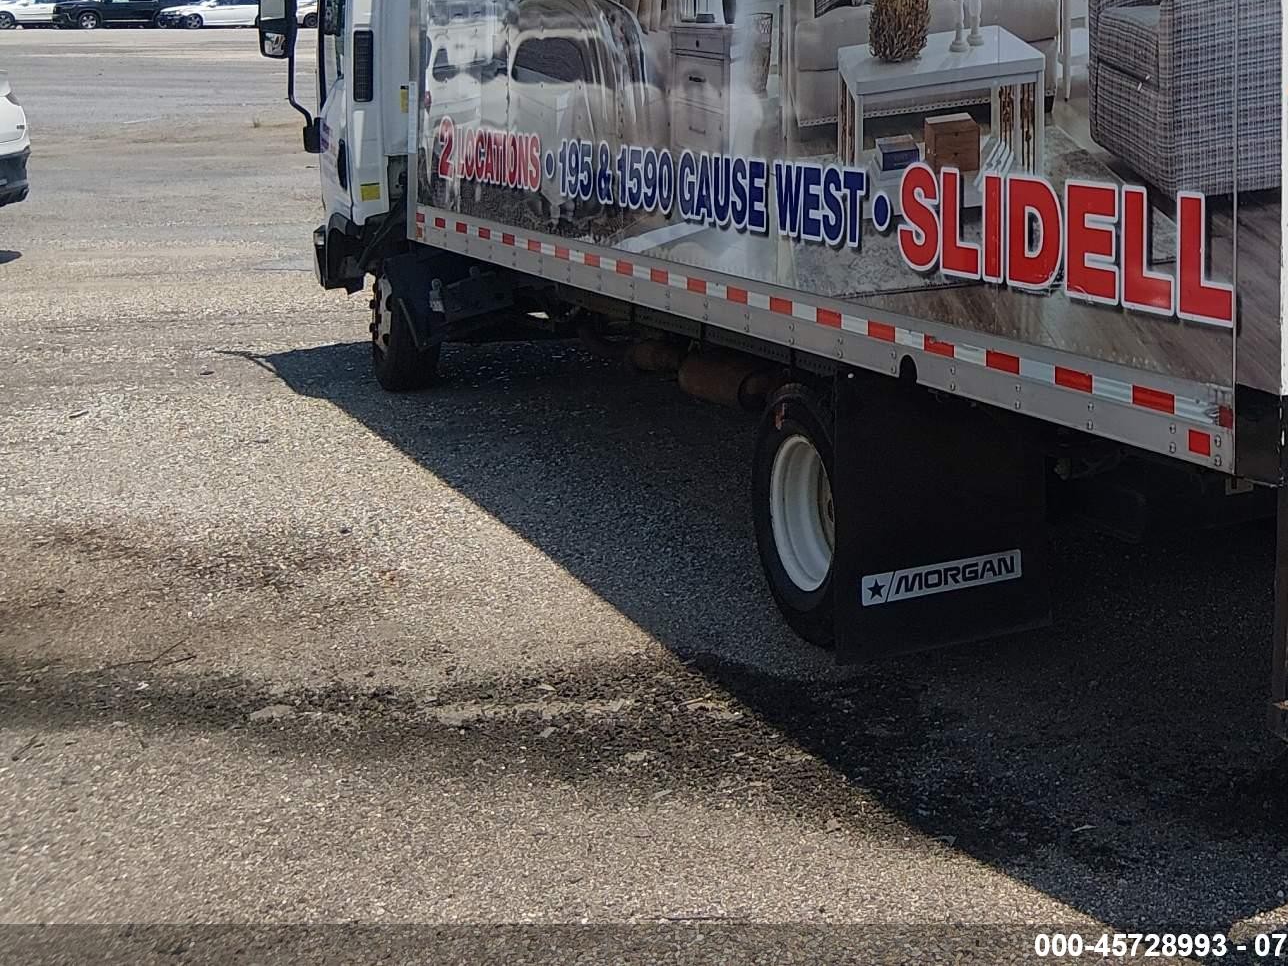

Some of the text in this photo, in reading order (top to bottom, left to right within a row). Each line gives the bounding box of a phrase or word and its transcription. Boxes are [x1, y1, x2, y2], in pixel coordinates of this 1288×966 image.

[439, 117, 454, 177] 2
[456, 129, 541, 190] LOCATIONS
[559, 140, 593, 199] 195
[618, 145, 673, 214] 1590
[678, 151, 767, 231] GAUSE
[775, 160, 866, 247] WEST
[897, 163, 1236, 324] SLIDELL
[895, 555, 1015, 595] MORGAN
